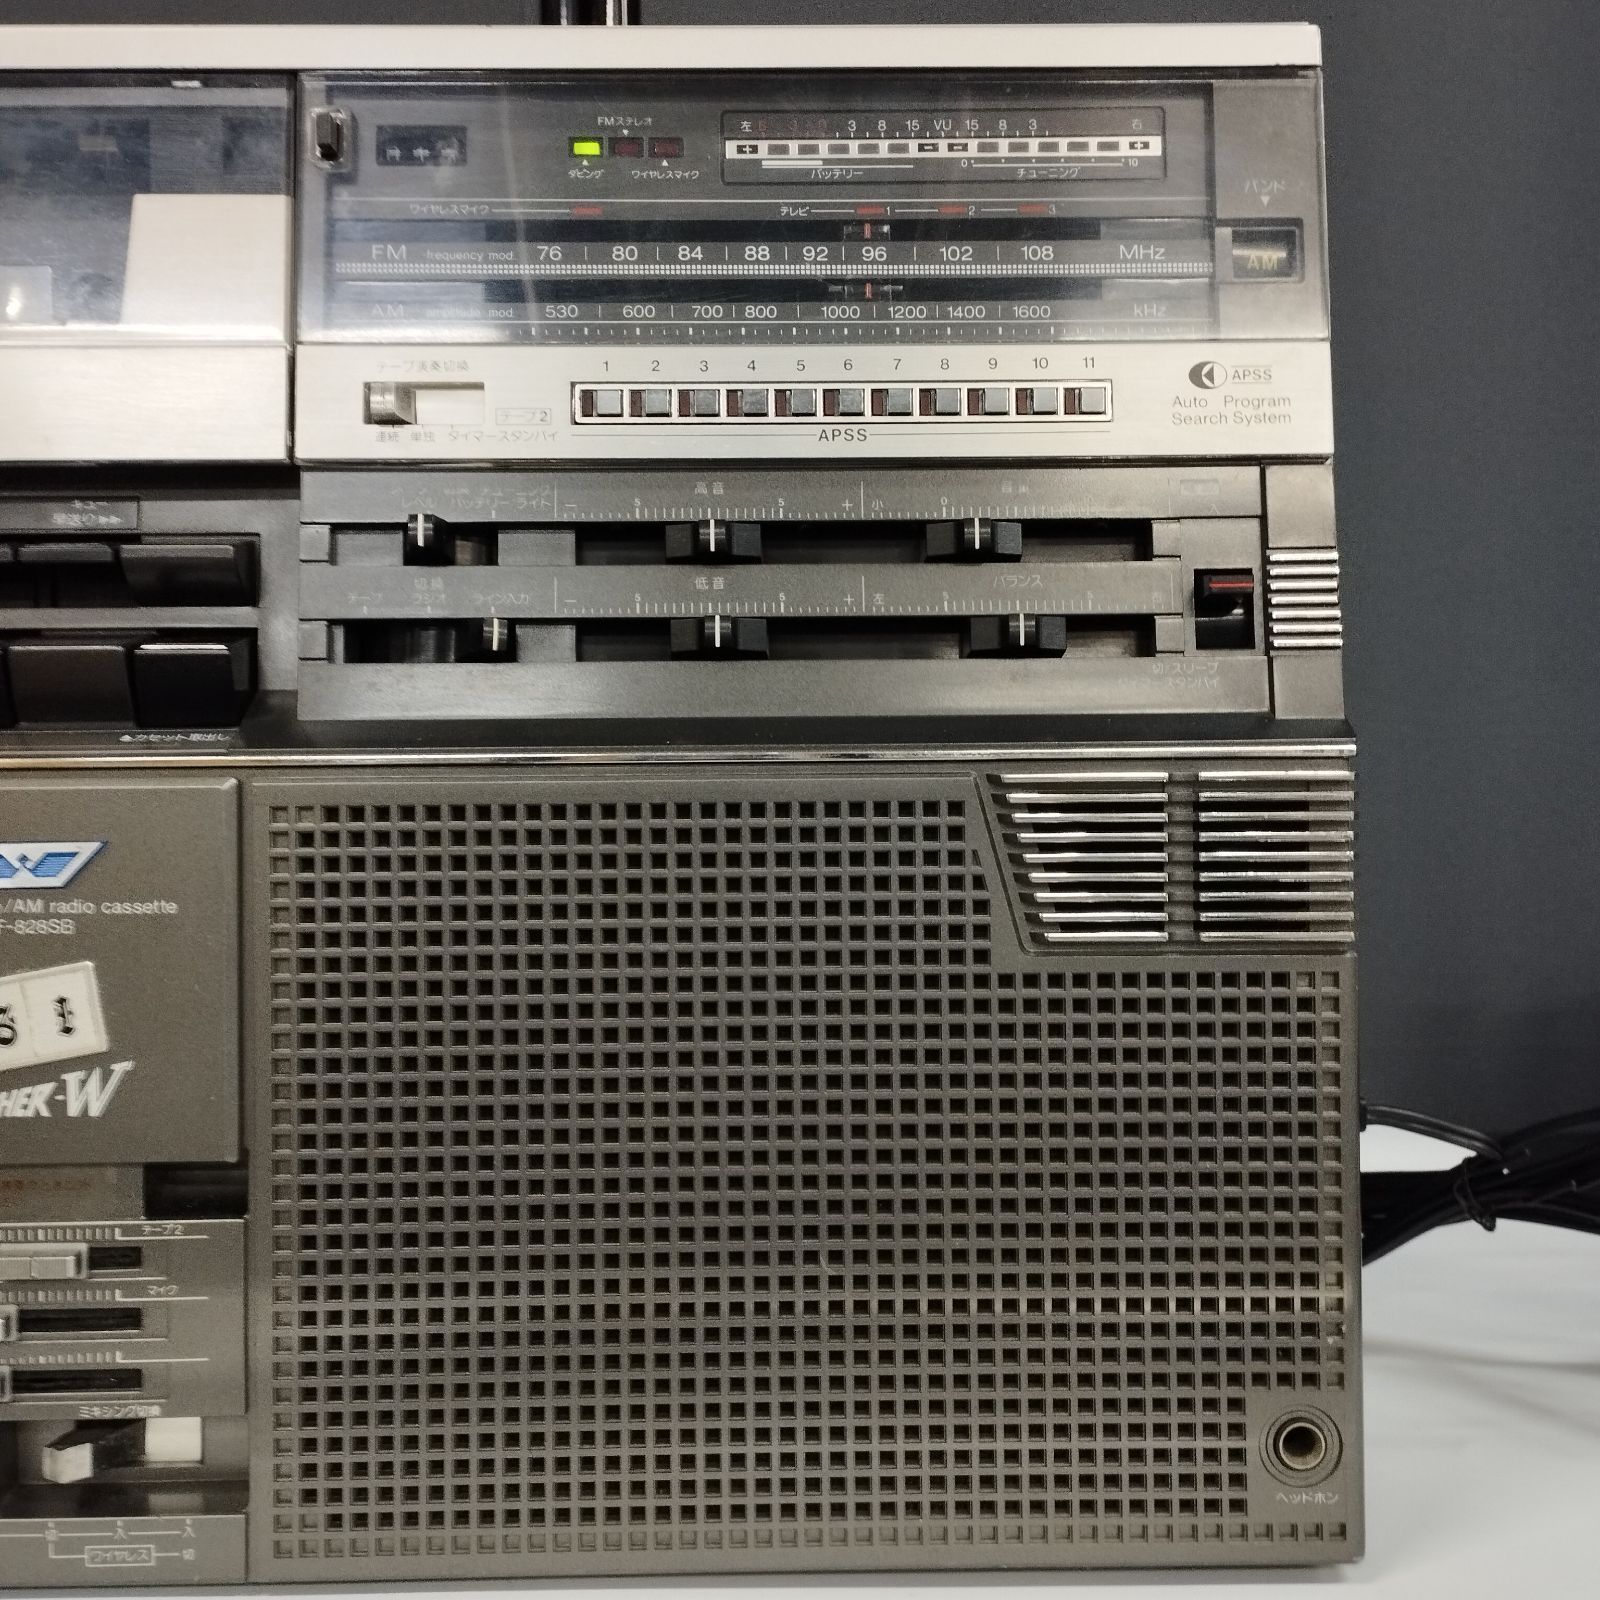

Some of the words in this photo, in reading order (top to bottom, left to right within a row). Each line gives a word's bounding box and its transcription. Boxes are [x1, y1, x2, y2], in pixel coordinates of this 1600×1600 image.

[740, 120, 752, 132] 左
[847, 120, 857, 132] 3
[877, 120, 887, 132] 8
[905, 120, 920, 131] 15
[933, 119, 951, 131] VU
[964, 119, 979, 131] 15
[998, 119, 1008, 131] 8
[1028, 119, 1038, 130] 3
[1128, 158, 1139, 168] 10
[631, 169, 700, 180] ワイヤレスマイク
[810, 168, 864, 180] バッテリー
[1016, 166, 1082, 179] チューニング
[780, 206, 810, 217] テレビ
[968, 206, 976, 216] 2
[371, 244, 408, 261] FM
[537, 246, 563, 261] 76
[611, 246, 638, 261] 80
[677, 246, 704, 261] 84
[744, 246, 770, 261] 88
[802, 246, 829, 261] 92
[861, 246, 887, 261] 96
[940, 246, 973, 261] 102
[1020, 245, 1054, 261] 108
[1119, 244, 1166, 260] MHz
[1246, 254, 1279, 271] AM
[545, 305, 579, 318] 530
[622, 305, 656, 318] 600
[692, 305, 723, 318] 700
[744, 305, 777, 318] 800
[821, 305, 860, 319] 1000
[888, 305, 927, 318] 1200
[949, 305, 986, 318] 1400
[1012, 305, 1051, 318] 1600
[1133, 304, 1168, 318] kHz
[603, 360, 609, 372] 1
[651, 360, 660, 372] 2
[699, 360, 709, 372] 3
[747, 360, 757, 372] 4
[796, 359, 806, 372] 5
[843, 359, 853, 371] 6
[892, 359, 902, 371] 7
[940, 358, 950, 370] 8
[988, 358, 998, 370] 9
[1032, 357, 1049, 369] 10
[1083, 357, 1096, 369] 11
[1231, 368, 1273, 382] APSS
[1172, 395, 1208, 409] Auto
[1223, 394, 1292, 411] Program
[1171, 411, 1228, 426] Search
[1232, 411, 1292, 427] System
[818, 428, 867, 442] APSS
[695, 576, 725, 590] 低音
[992, 574, 1044, 588] バランス
[49, 898, 97, 915] radio
[100, 899, 179, 915] cassette
